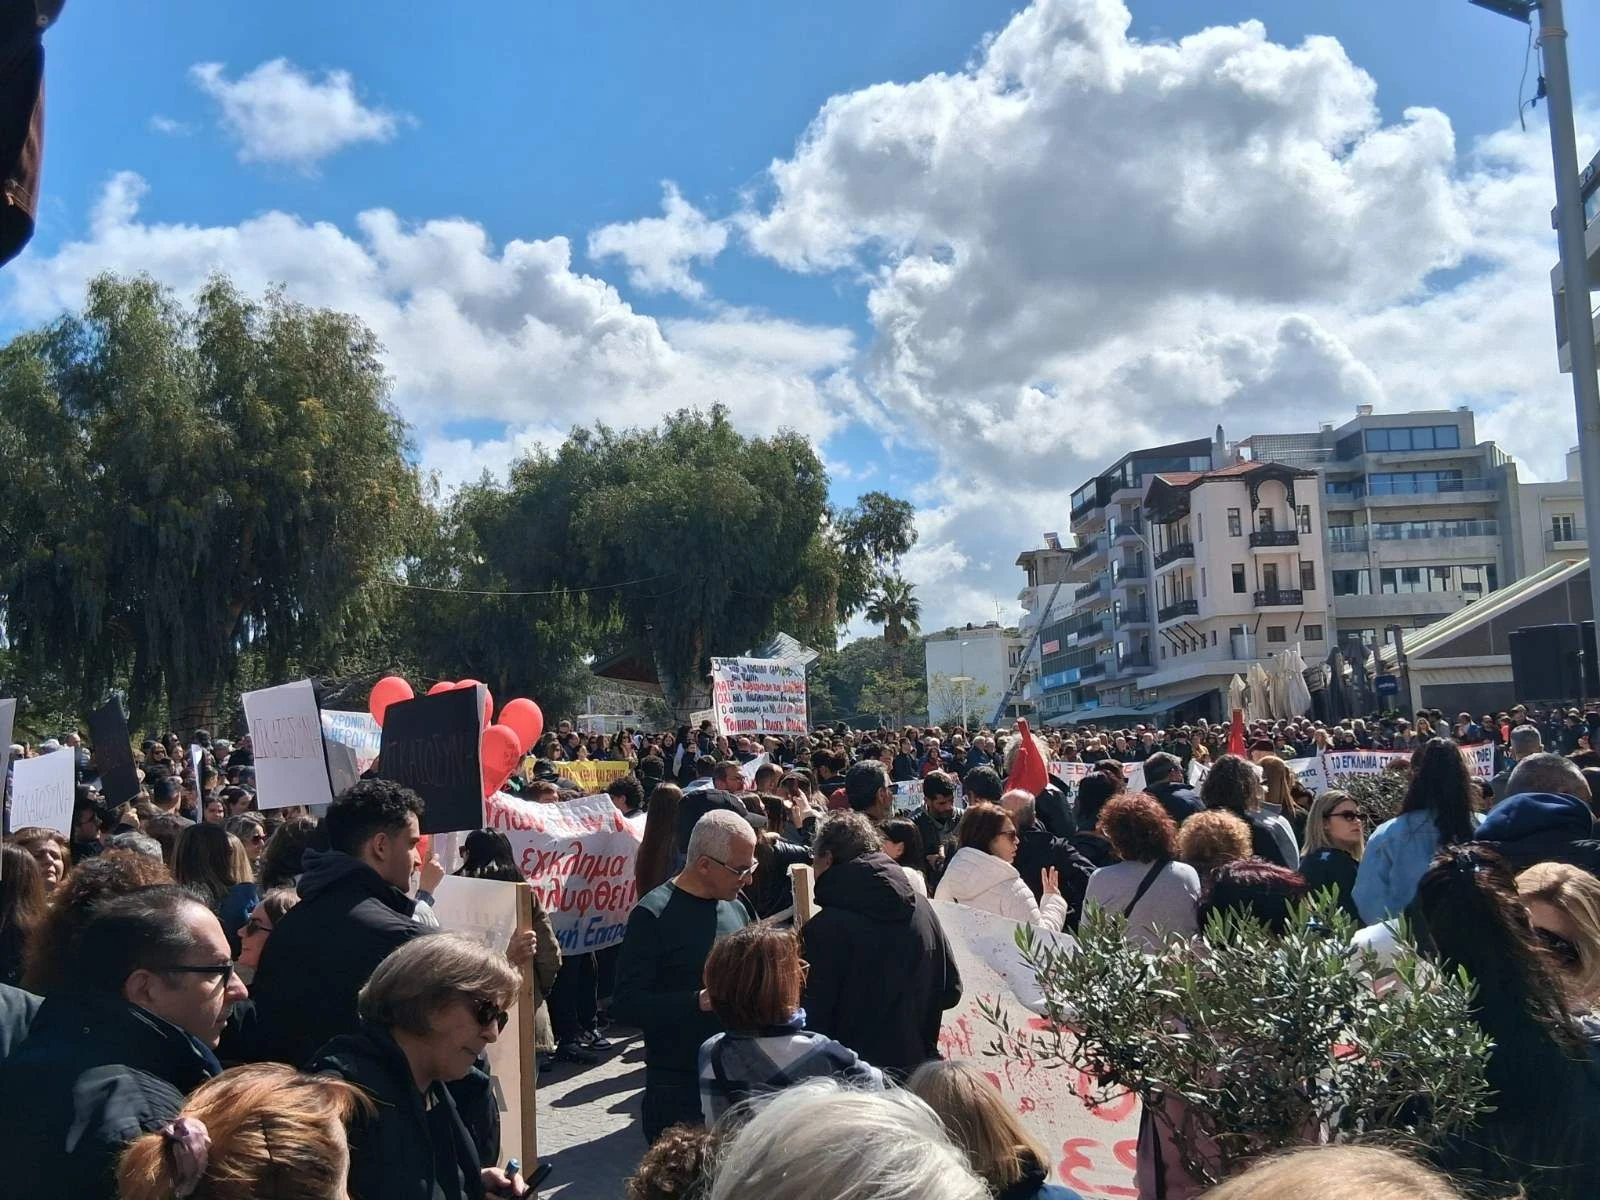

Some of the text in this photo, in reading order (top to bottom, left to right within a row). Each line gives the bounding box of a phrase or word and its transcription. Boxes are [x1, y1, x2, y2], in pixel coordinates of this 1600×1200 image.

[1331, 756, 1341, 769] ΤΟ
[1342, 755, 1377, 769] ΕΓΚΛΗΜΑ
[584, 916, 627, 949] Επιτρ
